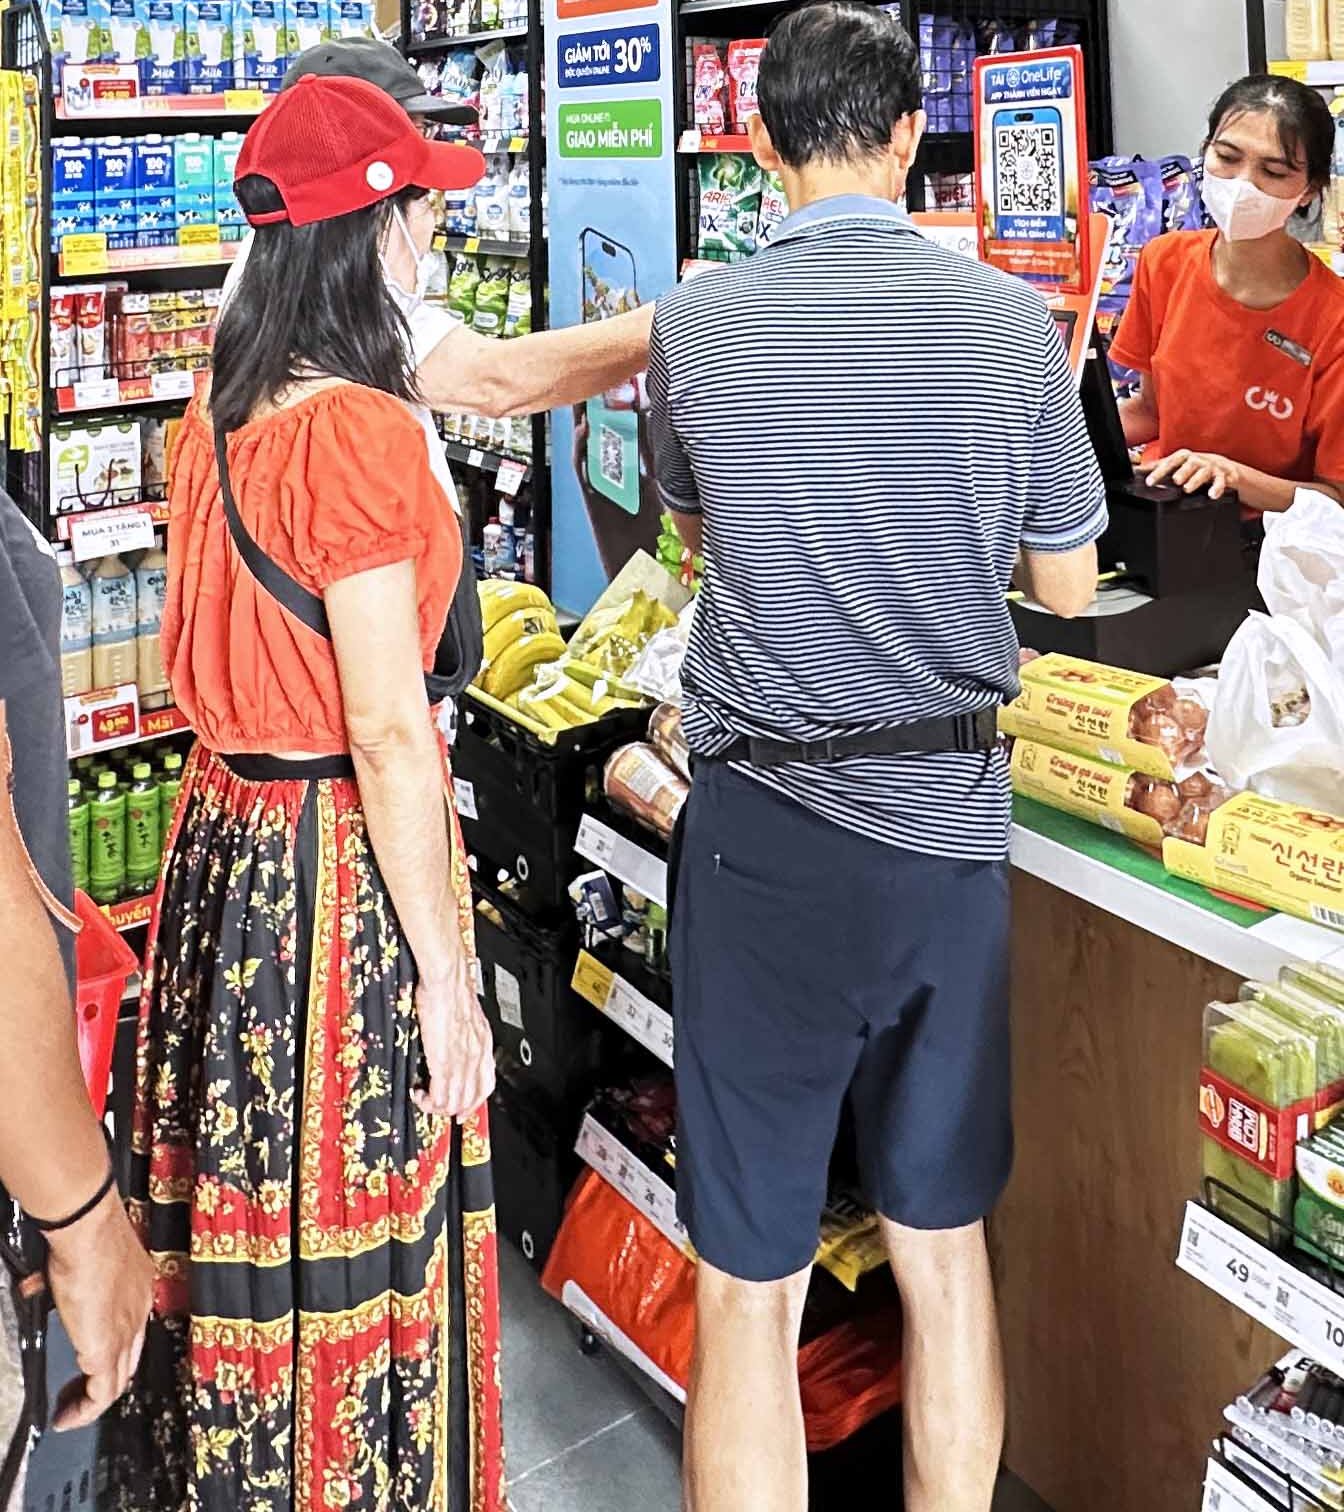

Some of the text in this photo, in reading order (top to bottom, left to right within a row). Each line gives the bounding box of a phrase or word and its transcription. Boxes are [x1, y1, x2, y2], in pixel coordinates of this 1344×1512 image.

[564, 35, 652, 74] GIẢM TỚI 30%
[991, 66, 1062, 86] TẢI OneLife
[566, 121, 654, 149] GIAO MIỄN PHÍ
[110, 906, 152, 927] huyến
